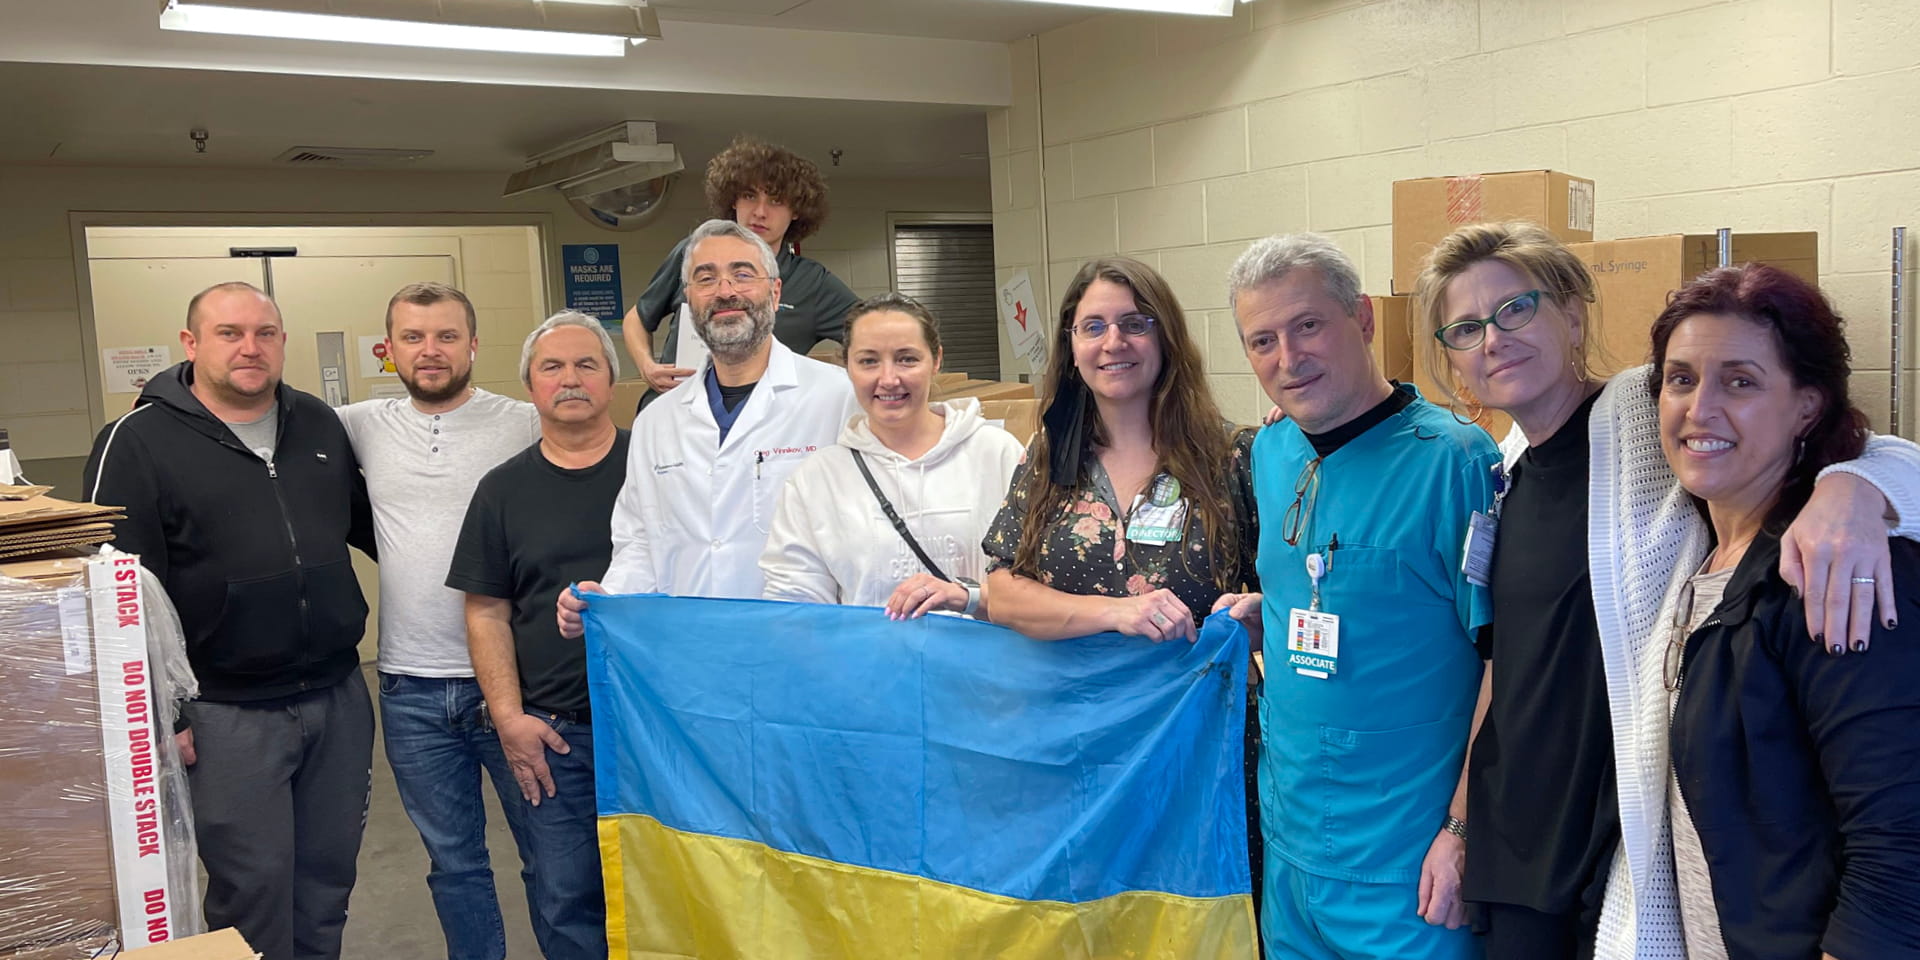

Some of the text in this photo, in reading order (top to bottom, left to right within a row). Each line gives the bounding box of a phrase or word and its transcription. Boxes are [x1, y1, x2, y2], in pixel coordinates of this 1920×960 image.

[570, 265, 614, 273] MASKS ARE
[1608, 259, 1648, 274] Syringe
[574, 274, 612, 283] REQUIRED
[754, 449, 770, 457] Oeg
[115, 569, 140, 628] STACK
[1289, 653, 1335, 671] ASSOCIATE
[123, 660, 160, 858] DO NOT DOUBLE STACK
[144, 888, 169, 944] DO NO
